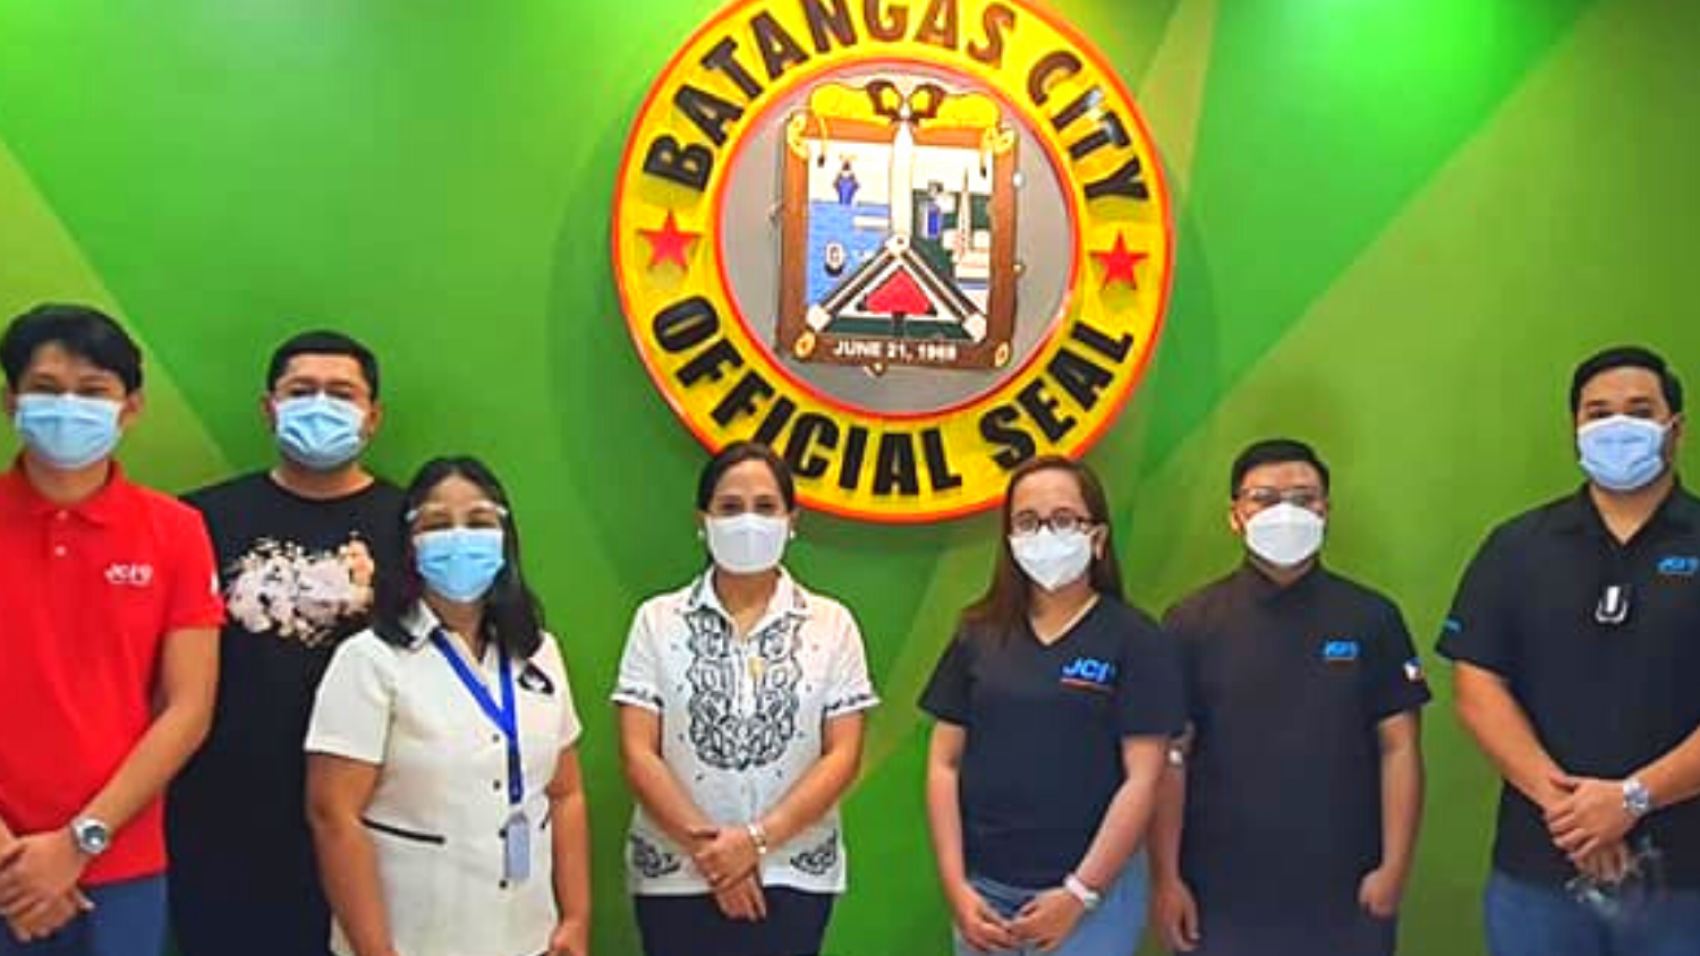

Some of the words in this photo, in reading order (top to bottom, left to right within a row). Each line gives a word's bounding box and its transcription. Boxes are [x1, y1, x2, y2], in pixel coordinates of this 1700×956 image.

[643, 0, 1015, 192] BATANGAS
[1027, 51, 1149, 199] CITY
[652, 296, 963, 496] OFFICIAL
[979, 321, 1134, 470] SEAL
[832, 340, 881, 358] JUNE
[1062, 658, 1109, 682] JCI
